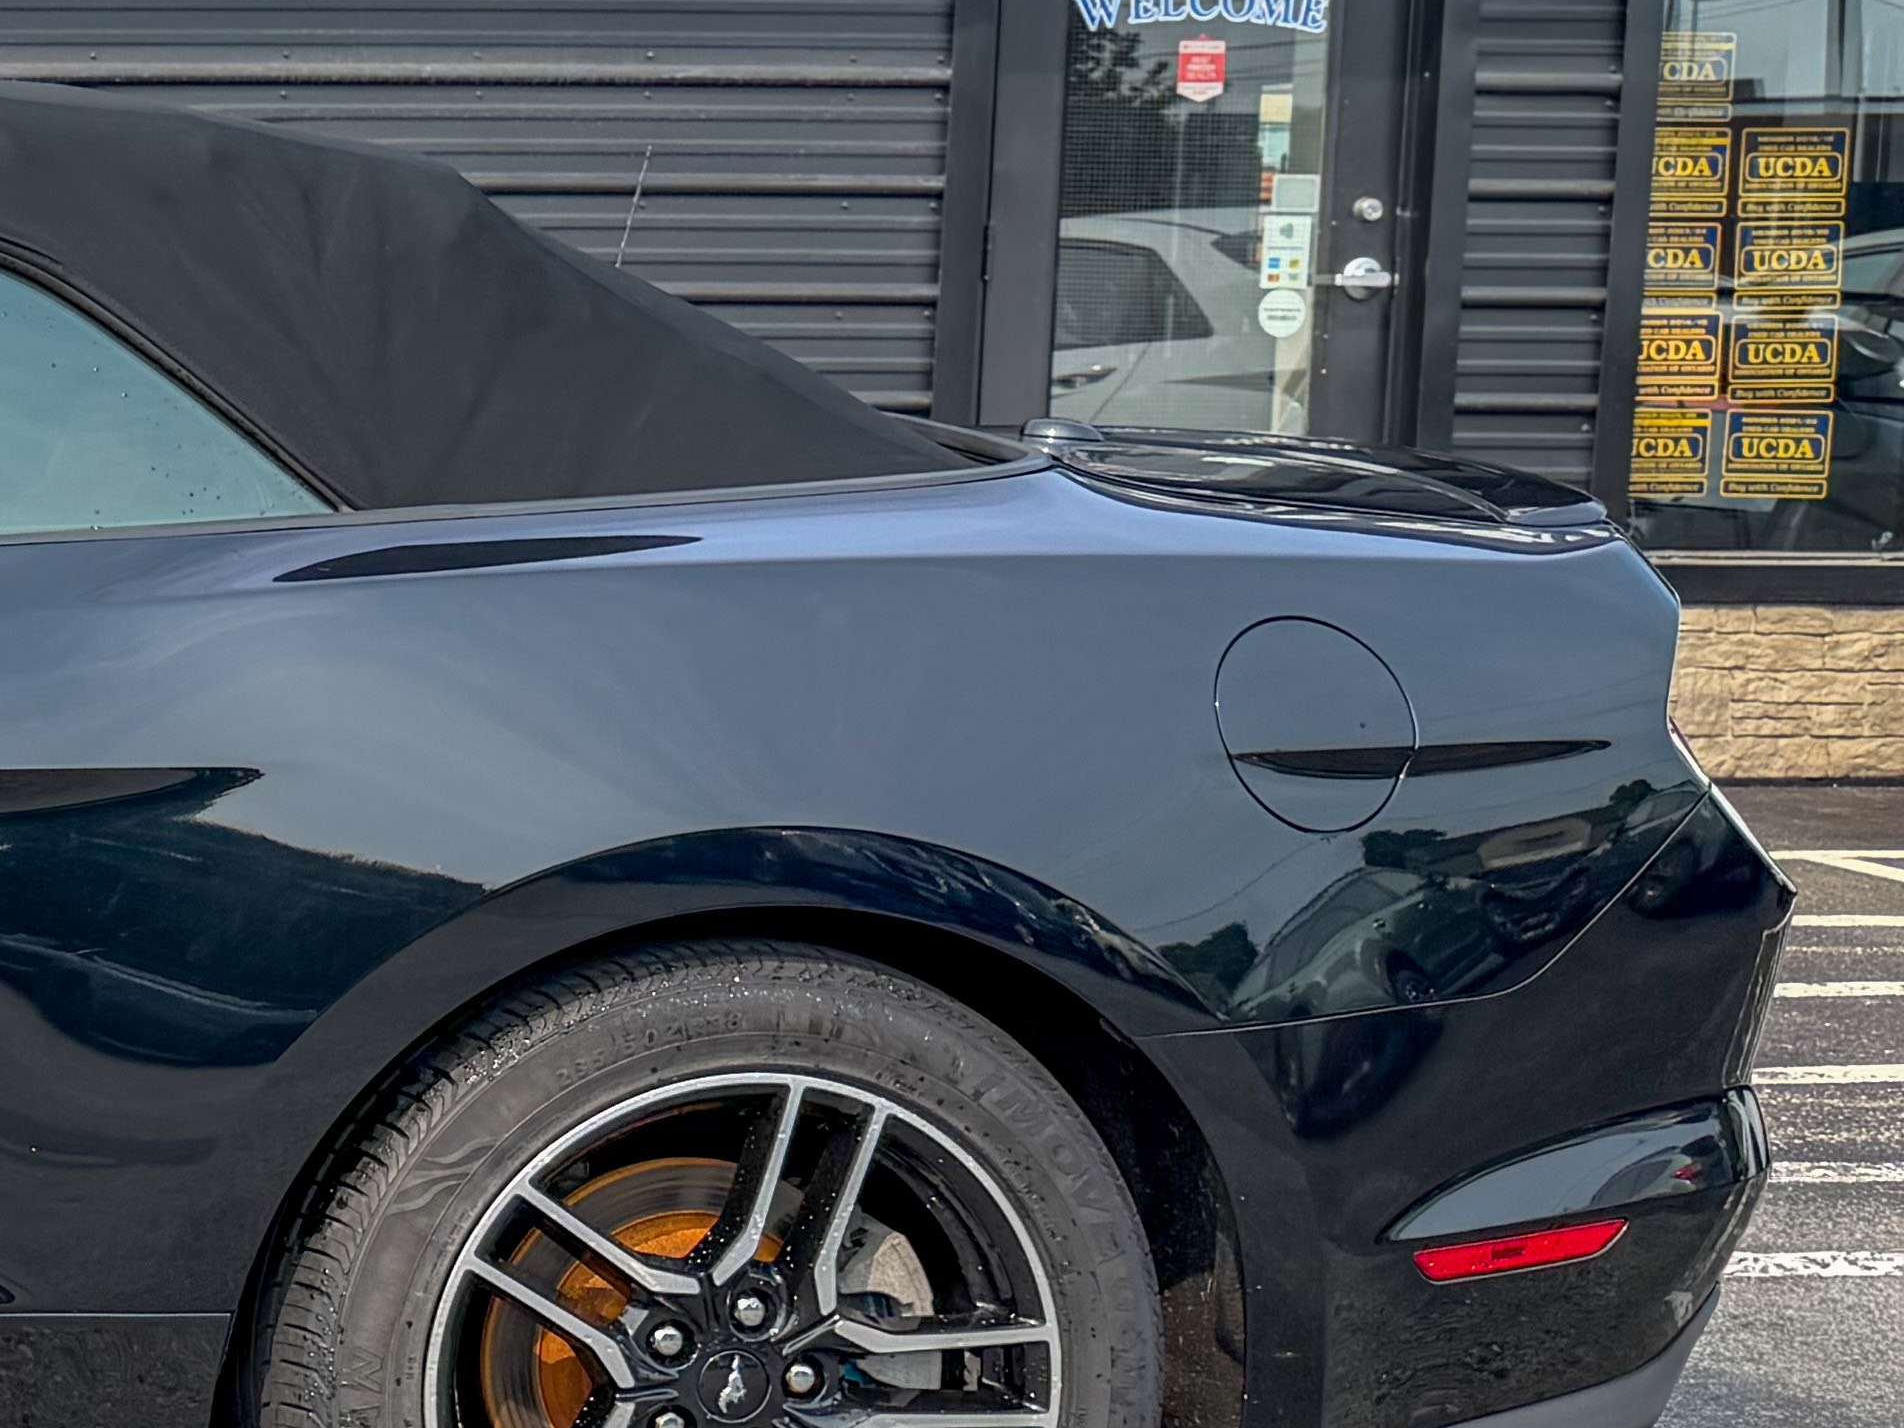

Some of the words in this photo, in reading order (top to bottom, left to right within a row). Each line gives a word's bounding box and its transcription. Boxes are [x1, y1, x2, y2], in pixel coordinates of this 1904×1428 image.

[1659, 61, 1717, 81] CDA
[1652, 157, 1713, 176] CDA
[1758, 157, 1832, 177] UCDA
[1647, 248, 1704, 268] CDA
[1752, 250, 1826, 270] UCDA
[1747, 343, 1821, 363] UCDA
[1741, 438, 1814, 458] UCDA
